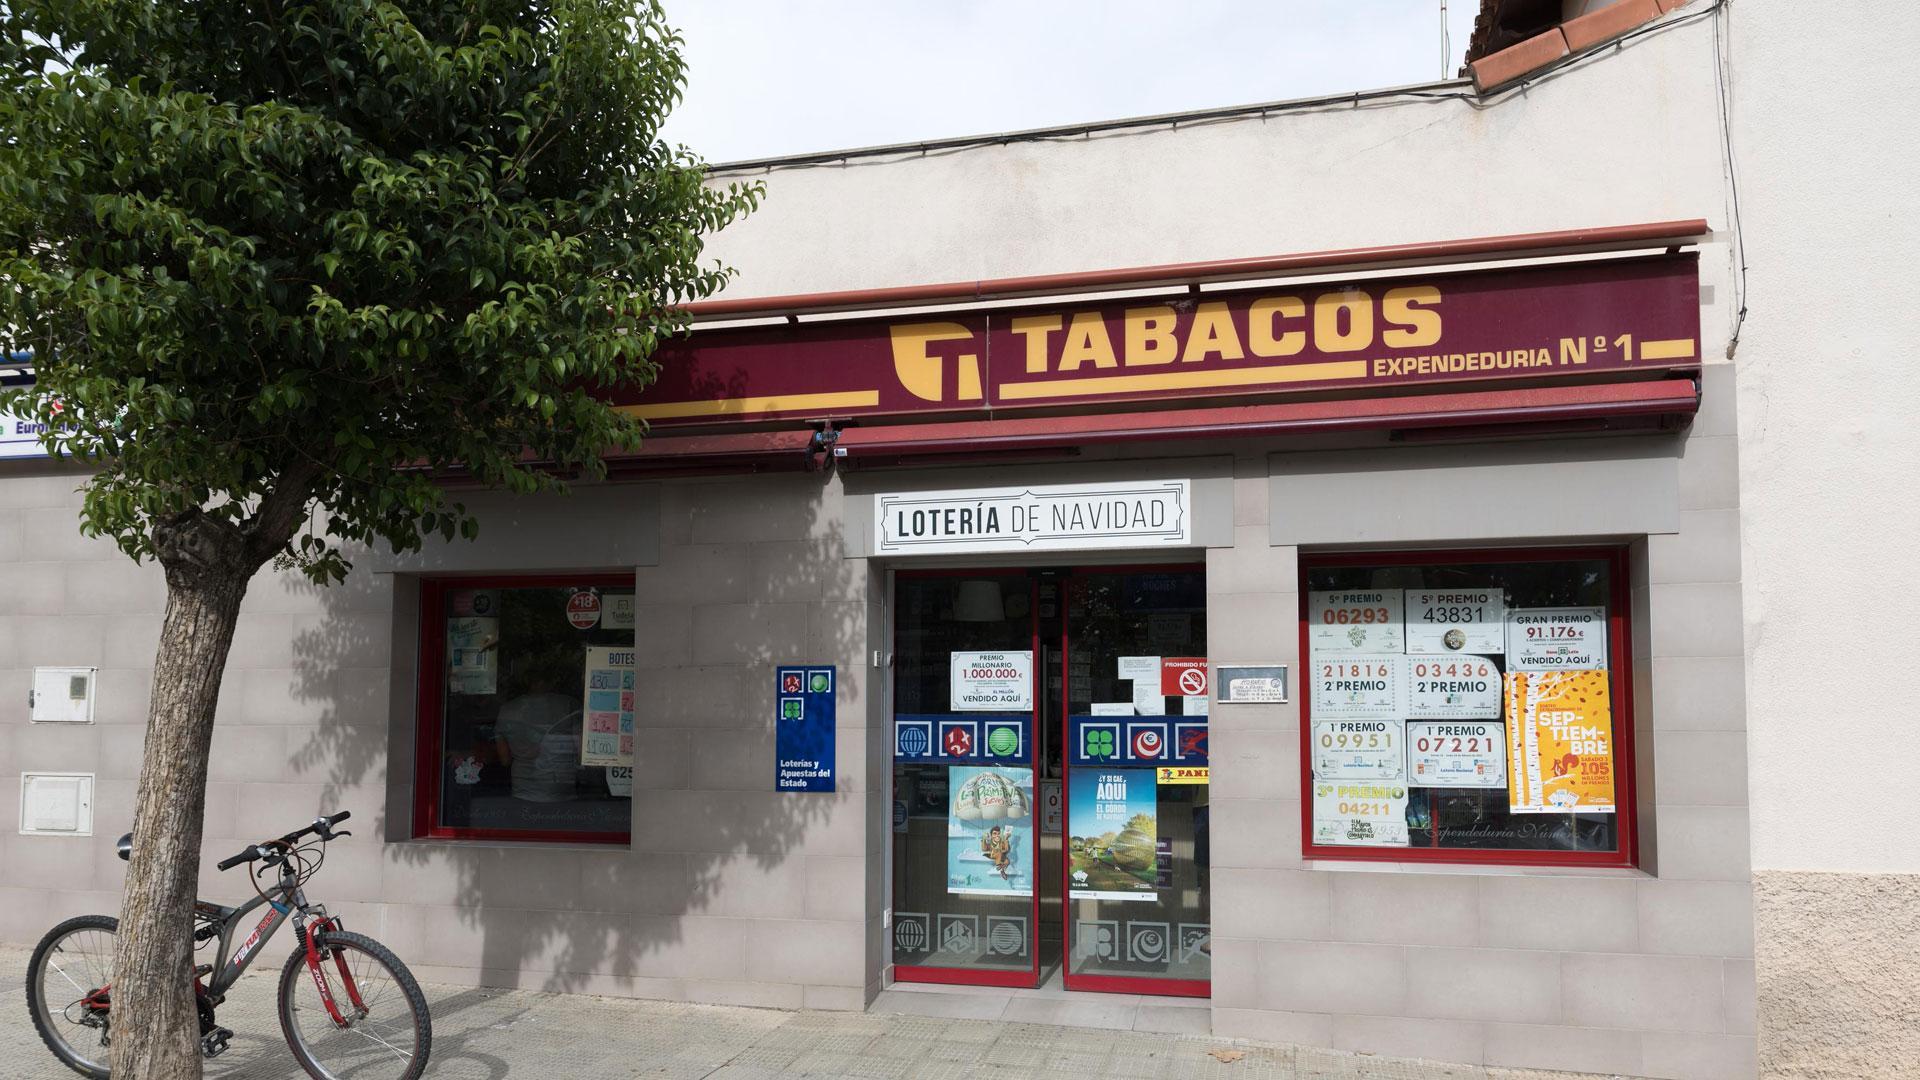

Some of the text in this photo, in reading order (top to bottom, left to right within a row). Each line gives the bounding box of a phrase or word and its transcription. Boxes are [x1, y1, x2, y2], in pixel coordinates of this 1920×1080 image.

[1011, 285, 1442, 373] TABACOS
[1373, 348, 1553, 377] EXPENDEDURIA
[1614, 333, 1633, 361] 1
[898, 499, 1165, 537] LOTERÍA DE NAVIDAD
[1343, 593, 1383, 604] PREMIO
[1438, 593, 1489, 604] PREMIO
[1323, 607, 1389, 625] 06293
[1423, 606, 1483, 623] 43831
[1516, 614, 1592, 624] GRAN PREMIO
[1526, 626, 1576, 638] 91.176
[608, 652, 635, 665] BOTES
[1520, 654, 1590, 665] VENDIDO AQUÍ
[963, 668, 1017, 679] 1.000.000
[1336, 680, 1386, 691] PREMIO
[1431, 681, 1487, 693] PREMIO
[1000, 693, 1021, 702] AQUÍ
[1539, 711, 1584, 726] SEP-
[1340, 722, 1386, 732] PREMIO
[1438, 726, 1486, 736] PREMIO
[1549, 726, 1605, 741] TIEM-
[1570, 740, 1608, 755] BRE
[780, 759, 819, 769] Loterías y
[1580, 761, 1610, 775] 105
[780, 769, 830, 779] Apuestas del
[1177, 769, 1209, 777] PANI
[780, 779, 807, 787] Estado
[1096, 780, 1127, 801] AQUÍ
[1337, 785, 1405, 800] PREMIO
[1339, 802, 1390, 816] 04211
